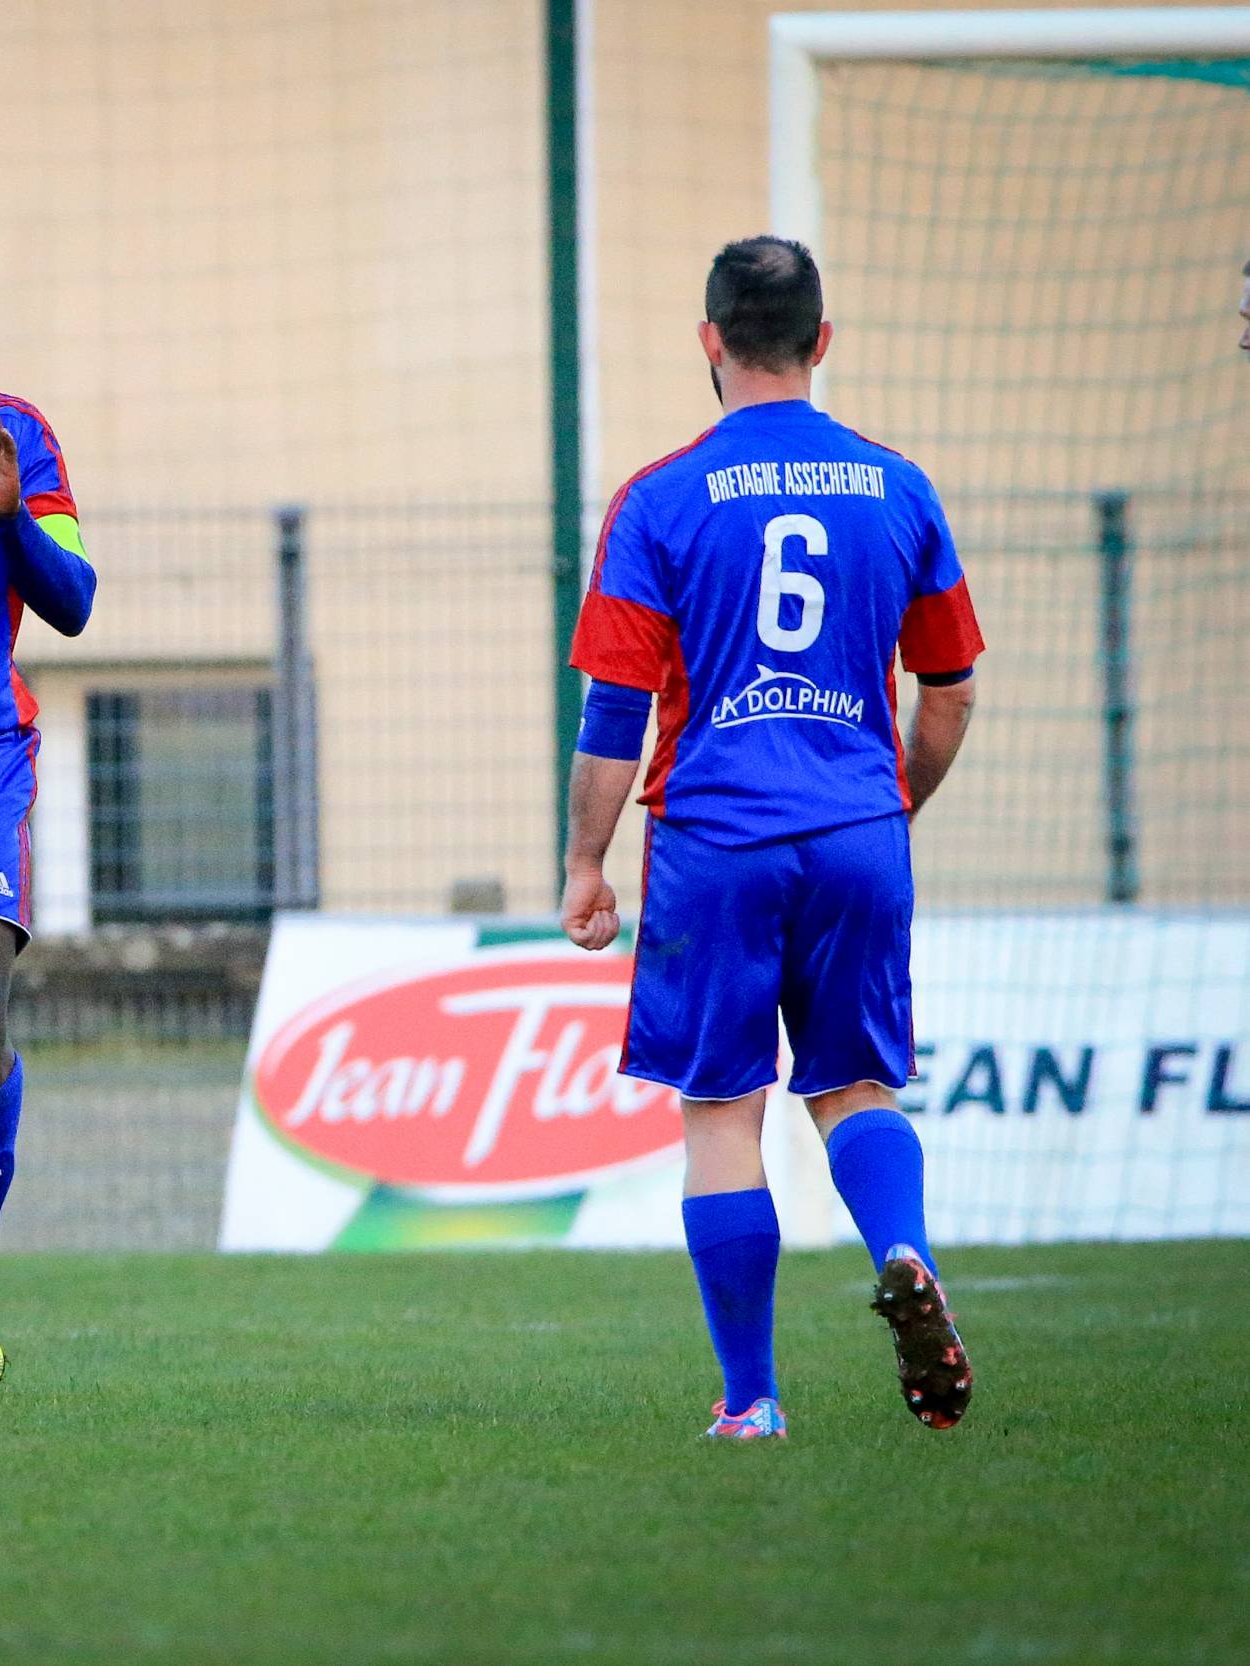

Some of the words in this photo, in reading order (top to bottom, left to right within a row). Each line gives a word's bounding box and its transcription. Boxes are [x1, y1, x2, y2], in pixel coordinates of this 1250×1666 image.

[706, 462, 781, 504] BRETAGNE
[783, 461, 885, 500] ASSECHEMENT
[756, 513, 829, 653] 6
[711, 696, 738, 724] LA
[747, 686, 864, 723] DOLPHINA
[284, 1018, 468, 1128] Jean
[900, 1042, 1094, 1114] EAN
[1140, 1042, 1250, 1114] FL
